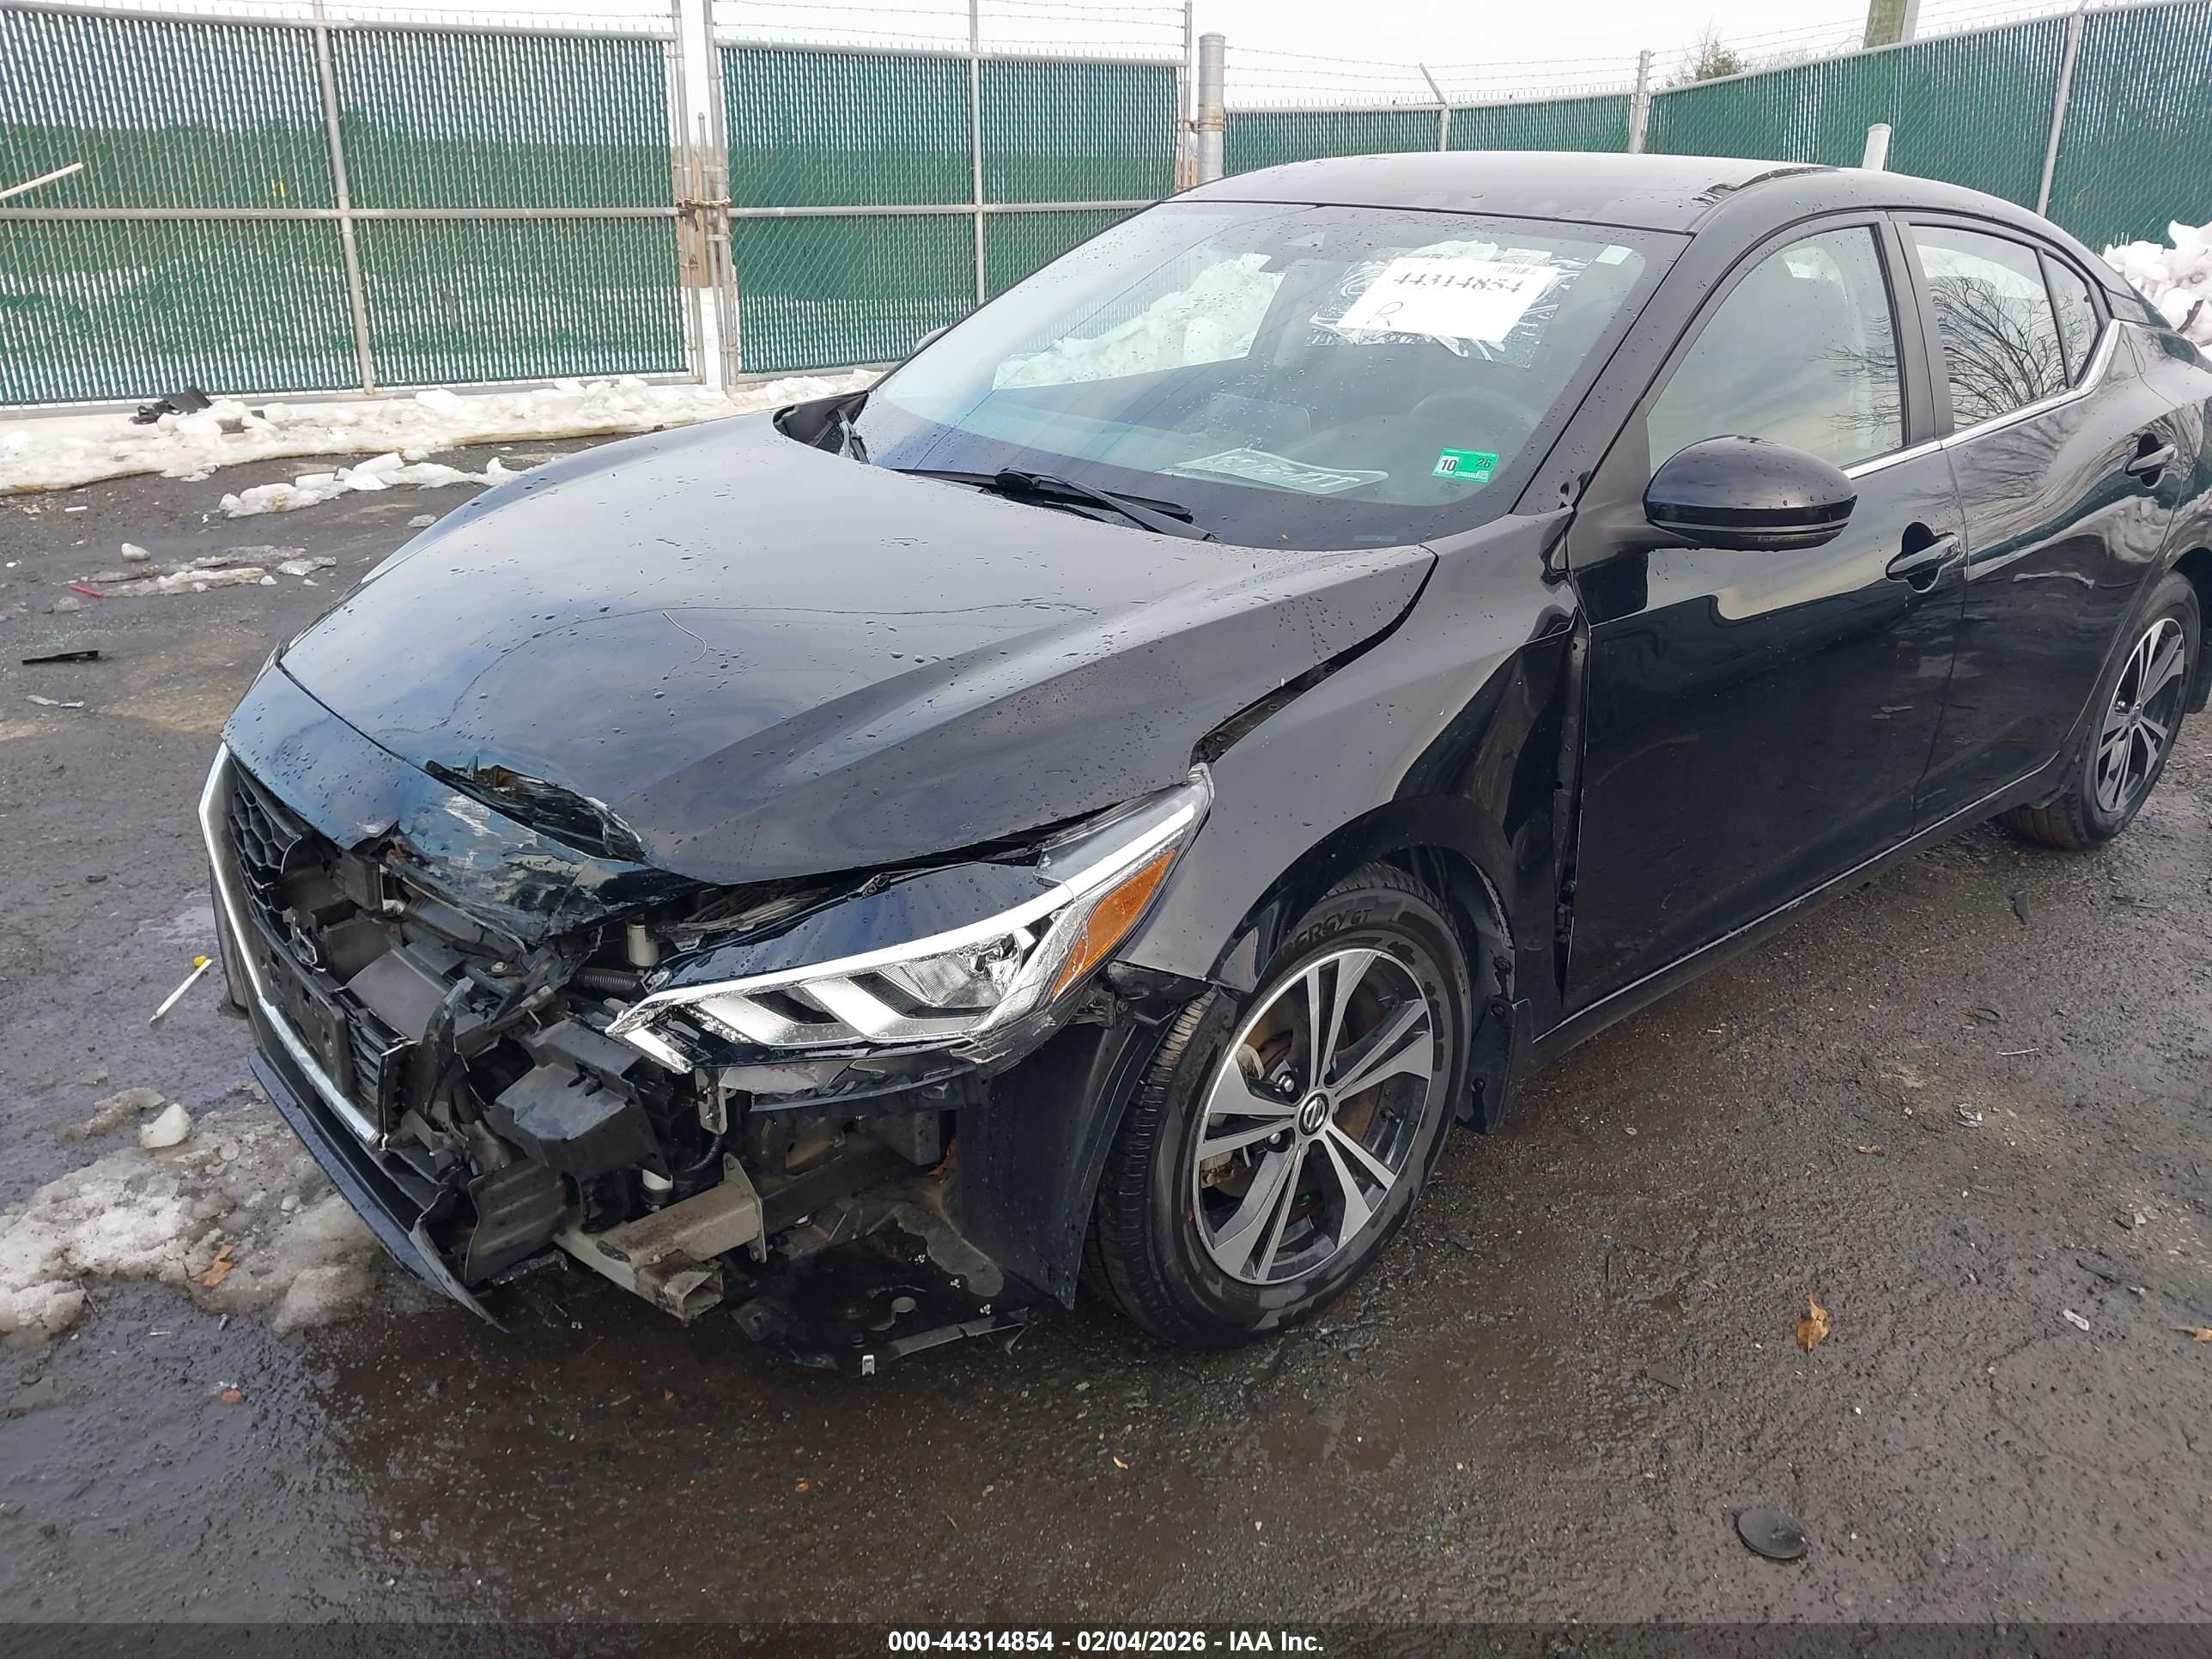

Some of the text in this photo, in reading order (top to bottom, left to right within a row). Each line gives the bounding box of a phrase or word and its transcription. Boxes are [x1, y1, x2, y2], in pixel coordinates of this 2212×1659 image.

[1393, 270, 1525, 294] 44314854
[1440, 457, 1492, 472] 10 26
